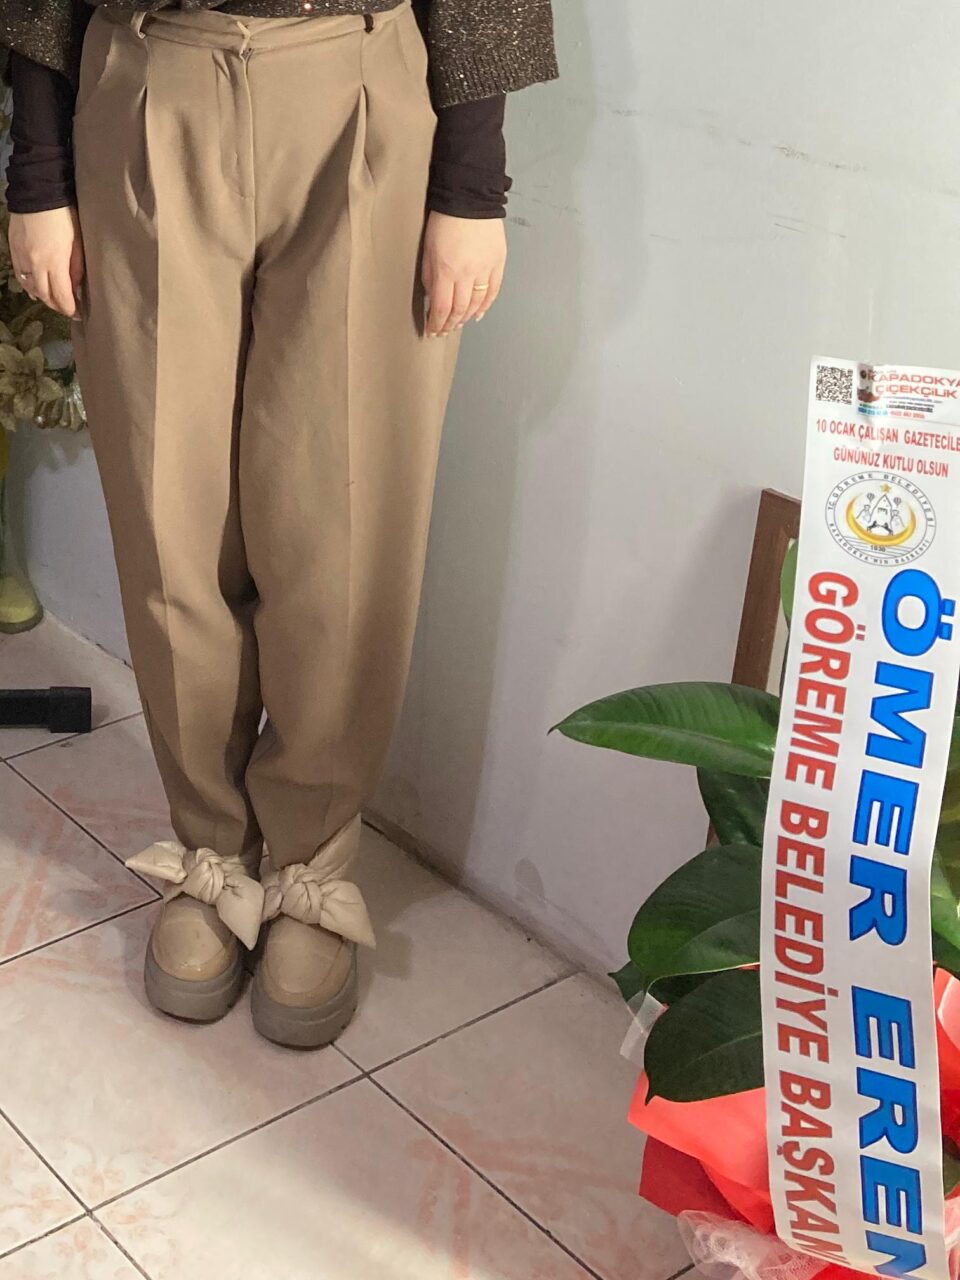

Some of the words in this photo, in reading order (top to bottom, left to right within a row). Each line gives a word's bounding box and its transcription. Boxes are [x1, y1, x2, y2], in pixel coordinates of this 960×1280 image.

[816, 419, 827, 433] 10
[830, 422, 856, 437] OCAK
[833, 445, 880, 468] GÜNÜNÜZ
[883, 455, 914, 473] KUTLU
[917, 460, 949, 477] OLSUN
[785, 571, 865, 791] GÖREME
[848, 568, 956, 946] ÖMER
[774, 799, 839, 1064] BELEDİYE
